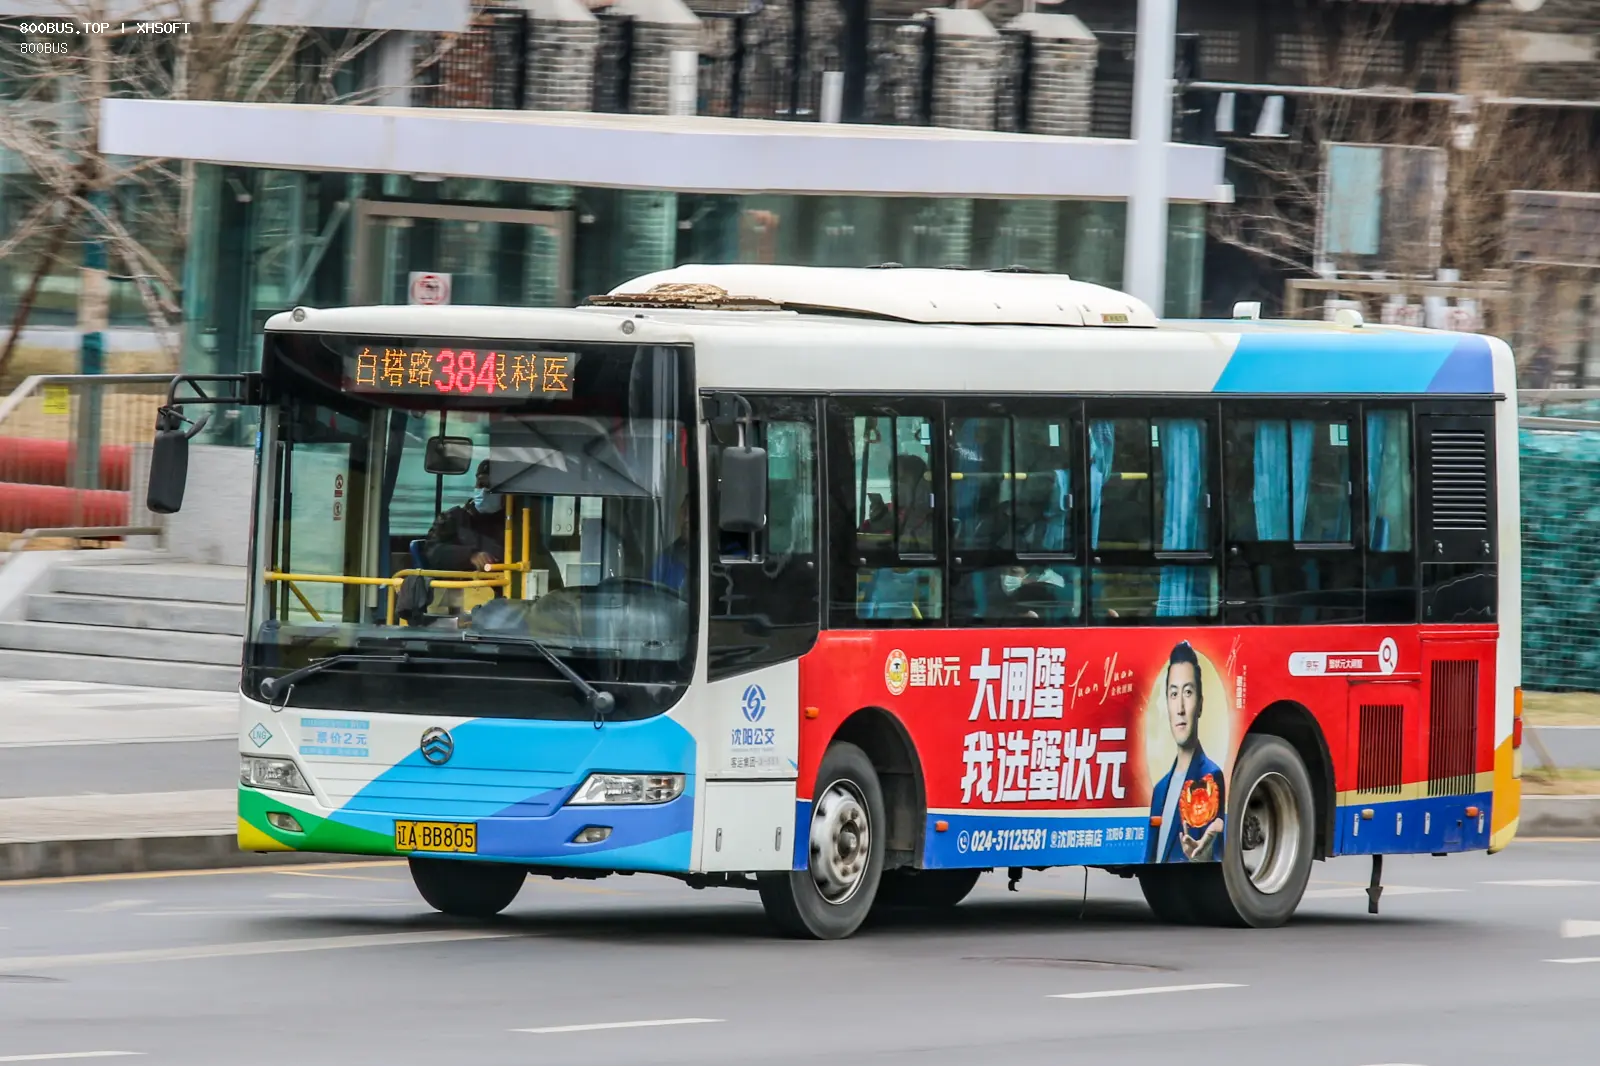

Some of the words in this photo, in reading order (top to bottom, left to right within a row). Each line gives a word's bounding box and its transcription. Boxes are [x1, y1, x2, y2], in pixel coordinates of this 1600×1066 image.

[356, 348, 433, 387] 白塔路
[434, 349, 497, 394] 384
[910, 656, 961, 687] 蟹状元
[968, 646, 1067, 721] 大闸蟹
[252, 731, 267, 740] LNG
[731, 727, 775, 746] 沈阳公交
[960, 727, 1128, 804] 我选蟹状元
[971, 828, 1048, 853] 024-31123581
